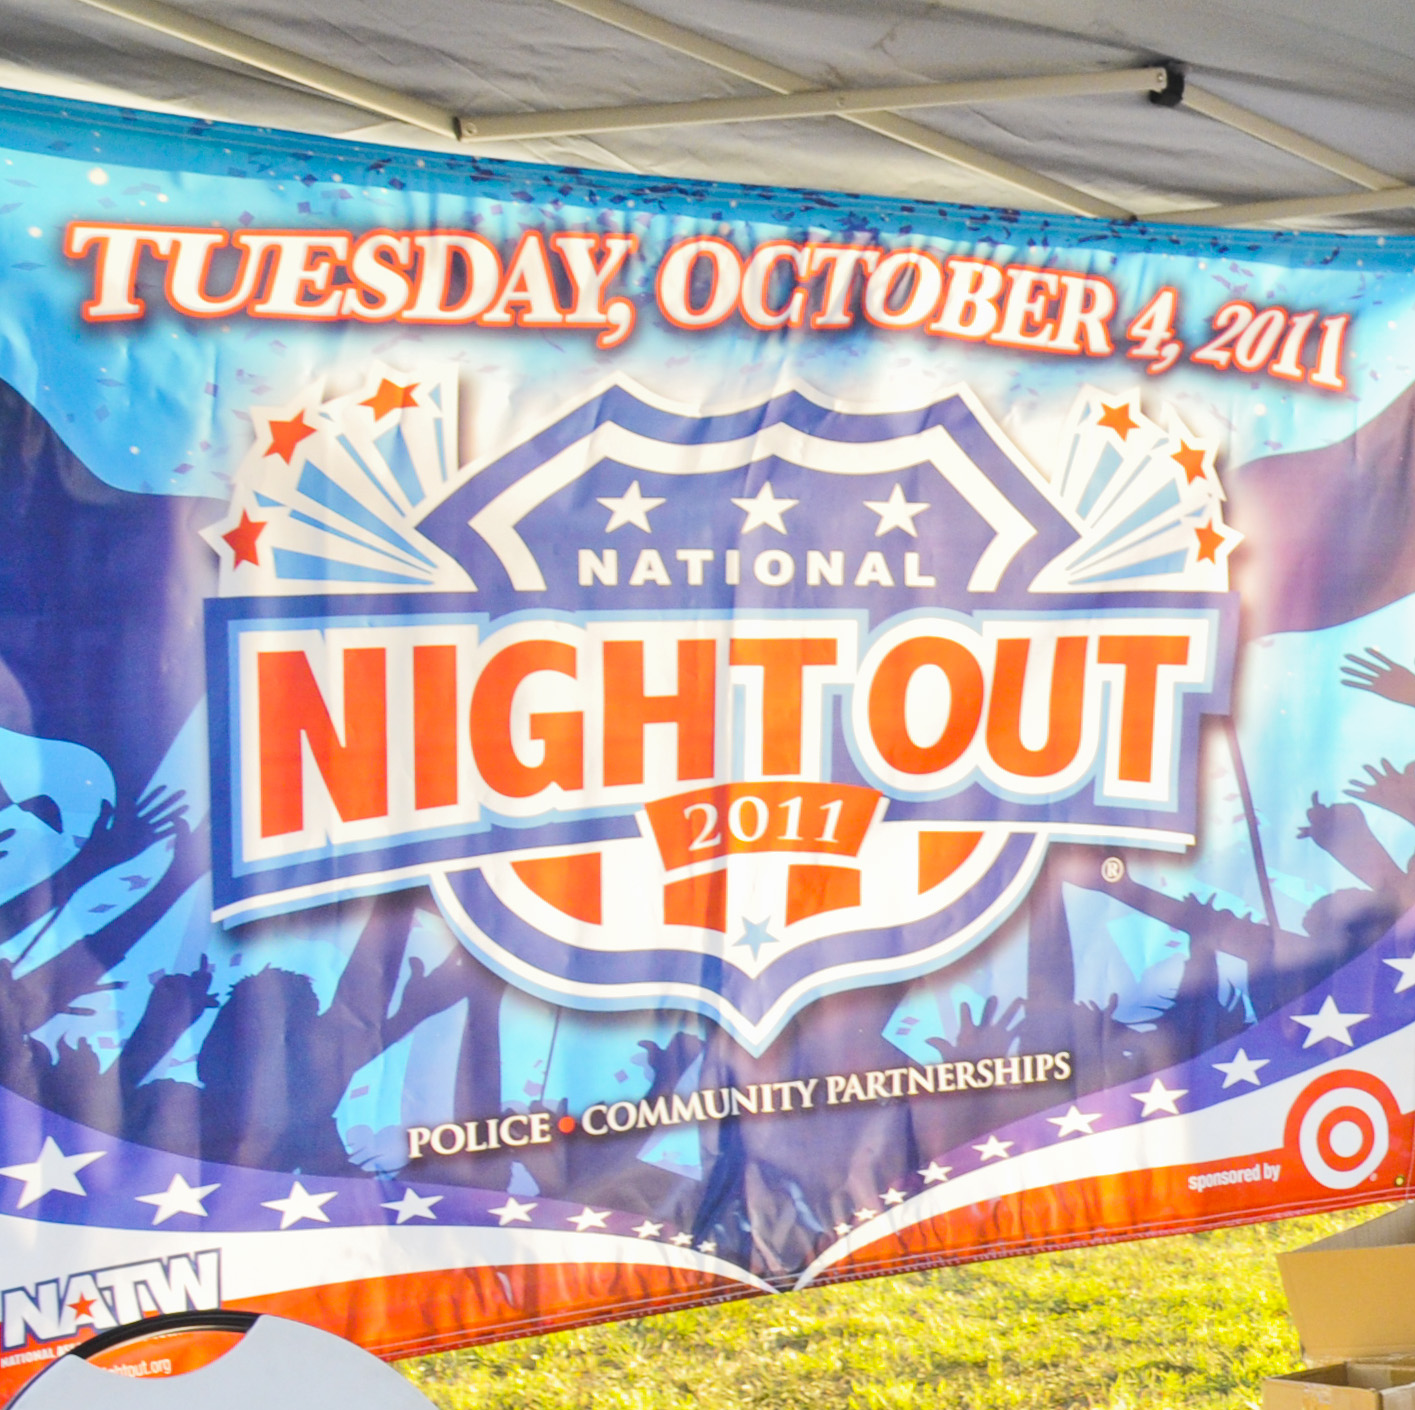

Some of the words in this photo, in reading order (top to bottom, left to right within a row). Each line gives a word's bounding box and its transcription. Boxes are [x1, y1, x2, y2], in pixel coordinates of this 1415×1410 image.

[66, 223, 637, 346] TUESDAY,
[656, 237, 1114, 355] OCTOBER
[1127, 286, 1184, 373] 4,
[1196, 302, 1350, 389] 2011
[578, 549, 936, 588] NATIONAL
[256, 636, 838, 840] NIGHT
[866, 634, 1192, 784] OUT
[682, 796, 844, 852] 2011
[406, 1112, 552, 1160] POLICE
[580, 1077, 818, 1137] COMMUNITY
[825, 1052, 1072, 1107] PARTNERSHIPS
[1188, 1164, 1262, 1193] sponsored
[1263, 1162, 1281, 1182] by
[2, 1249, 222, 1349] NATW
[1, 1346, 55, 1369] NATIONAL
